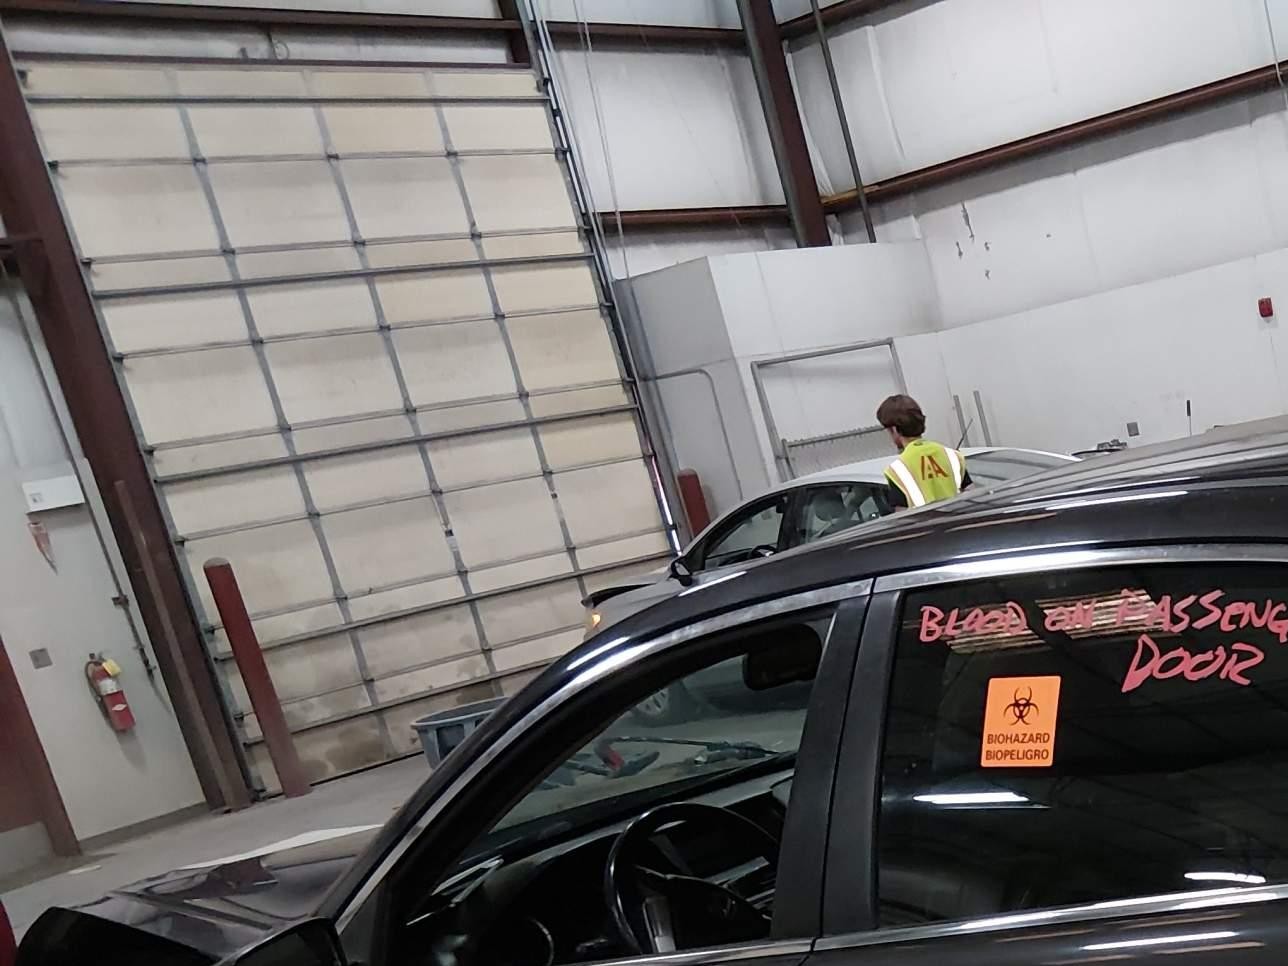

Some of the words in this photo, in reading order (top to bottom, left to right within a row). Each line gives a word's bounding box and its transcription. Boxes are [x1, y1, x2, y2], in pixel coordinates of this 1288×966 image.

[919, 601, 1028, 642] BLOOD
[1044, 598, 1096, 632] ON
[1121, 634, 1265, 693] DOOR
[986, 732, 1051, 745] BIOHAZARD
[985, 748, 1050, 761] BIOPELIGRO
